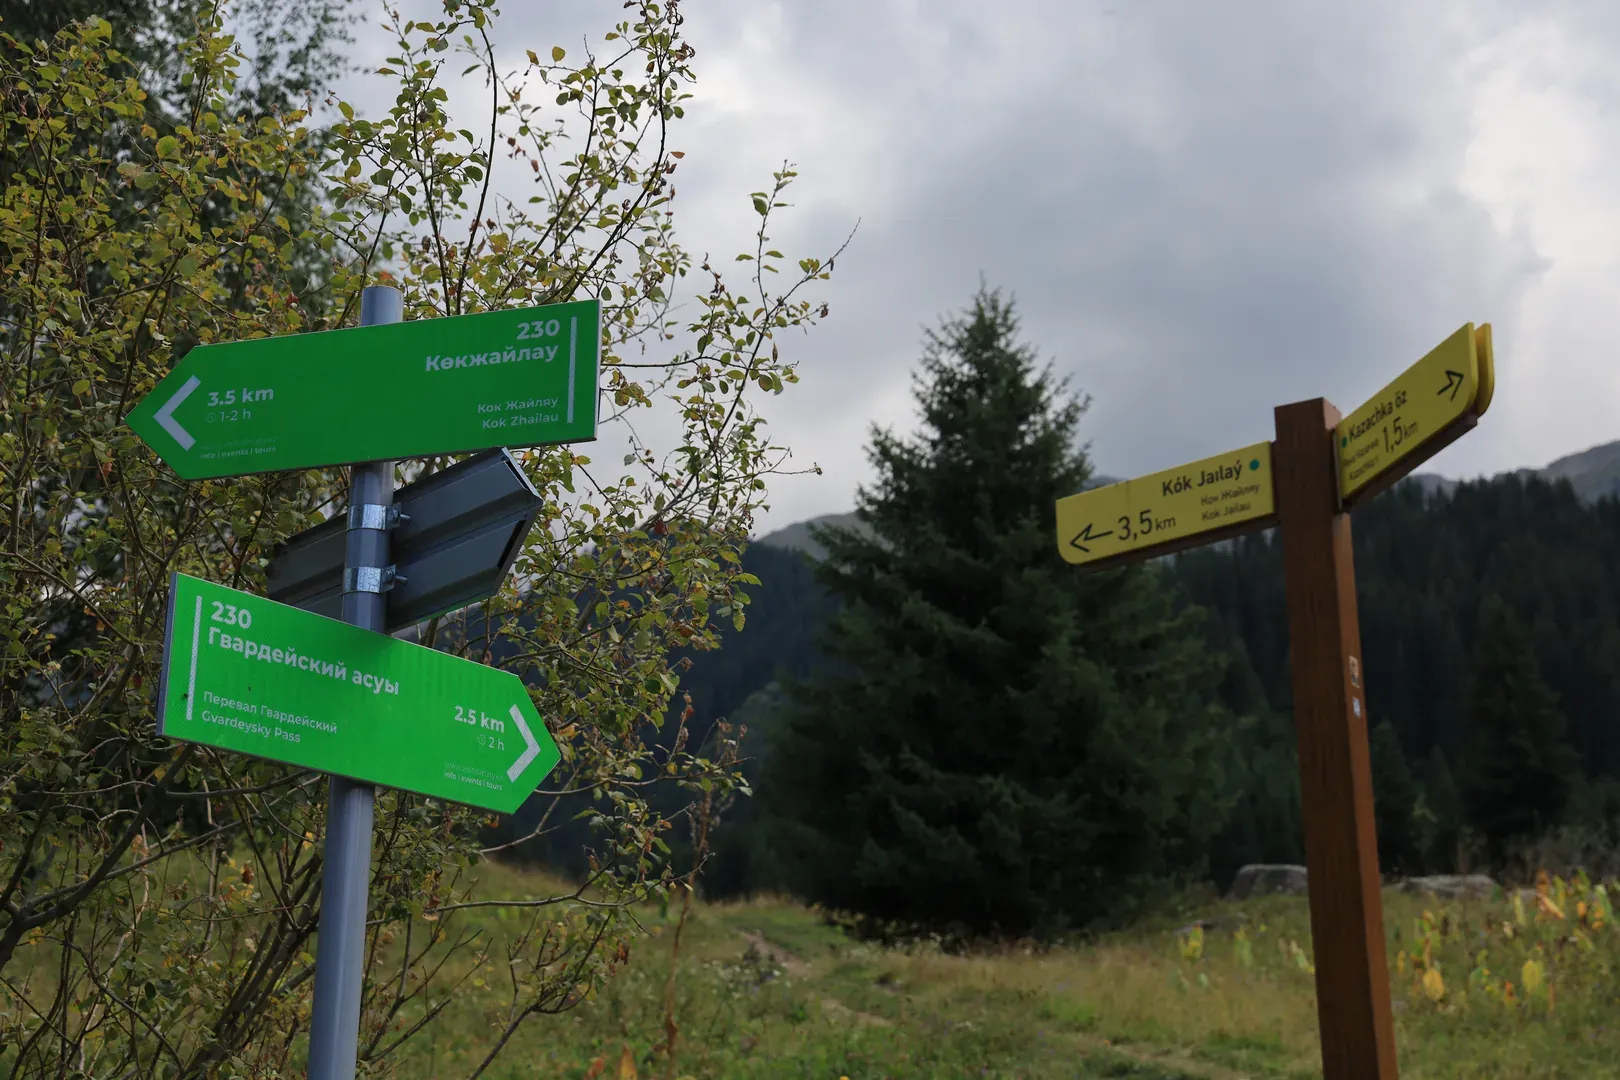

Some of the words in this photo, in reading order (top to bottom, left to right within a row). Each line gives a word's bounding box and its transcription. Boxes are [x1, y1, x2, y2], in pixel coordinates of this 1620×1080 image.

[516, 318, 561, 340] 230
[425, 344, 559, 372] Көкжайлау
[207, 389, 237, 407] 3.5
[242, 387, 274, 404] km
[477, 403, 502, 414] Кок
[506, 397, 559, 411] Жайляу
[219, 409, 238, 422] 1-2
[242, 408, 252, 420] h
[482, 417, 507, 429] Kok
[511, 413, 559, 427] Zhailau
[1382, 415, 1403, 454] 1,5
[1403, 420, 1418, 440] km
[221, 447, 249, 458] events
[254, 445, 277, 454] tours
[1162, 474, 1193, 497] Kók
[1117, 508, 1153, 542] 3,5
[1155, 515, 1177, 531] km
[210, 600, 252, 629] 230
[208, 626, 347, 681] Гвардейский
[351, 669, 400, 696] асуы
[203, 690, 258, 715] Перевал
[260, 704, 338, 734] Гвардейский
[454, 705, 477, 725] 2.5
[480, 711, 505, 734] km
[274, 727, 301, 743] Pass
[488, 736, 495, 749] 2
[497, 738, 505, 751] h
[486, 780, 503, 792] tours
